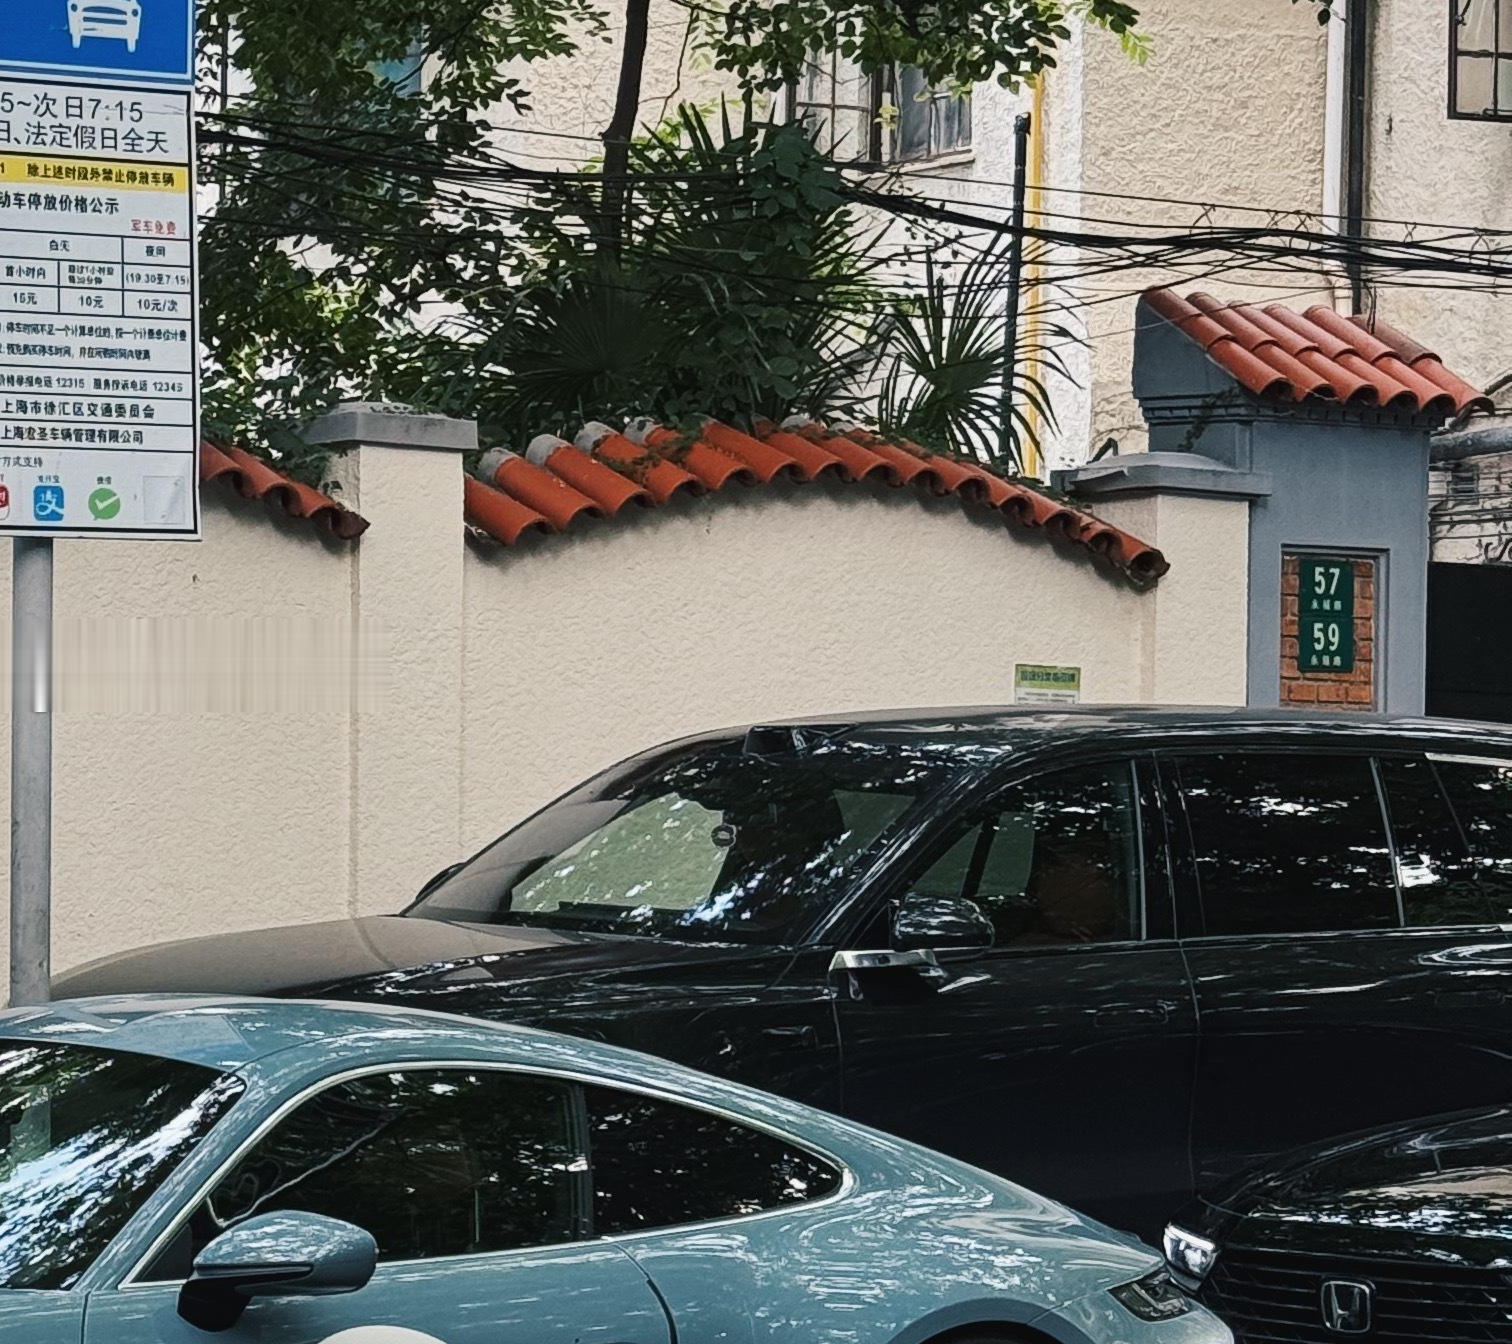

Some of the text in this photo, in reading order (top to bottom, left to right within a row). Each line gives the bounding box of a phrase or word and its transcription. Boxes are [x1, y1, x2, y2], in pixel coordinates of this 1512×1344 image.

[27, 163, 175, 187] 除上述时段外禁止停放车辆
[79, 295, 104, 309] 10元
[137, 299, 178, 312] 10元/次
[56, 378, 85, 388] 12315
[152, 381, 183, 392] 12345
[1, 399, 155, 419] 上海市徐汇区交通委员会
[1314, 566, 1341, 595] 57
[1313, 622, 1340, 651] 59
